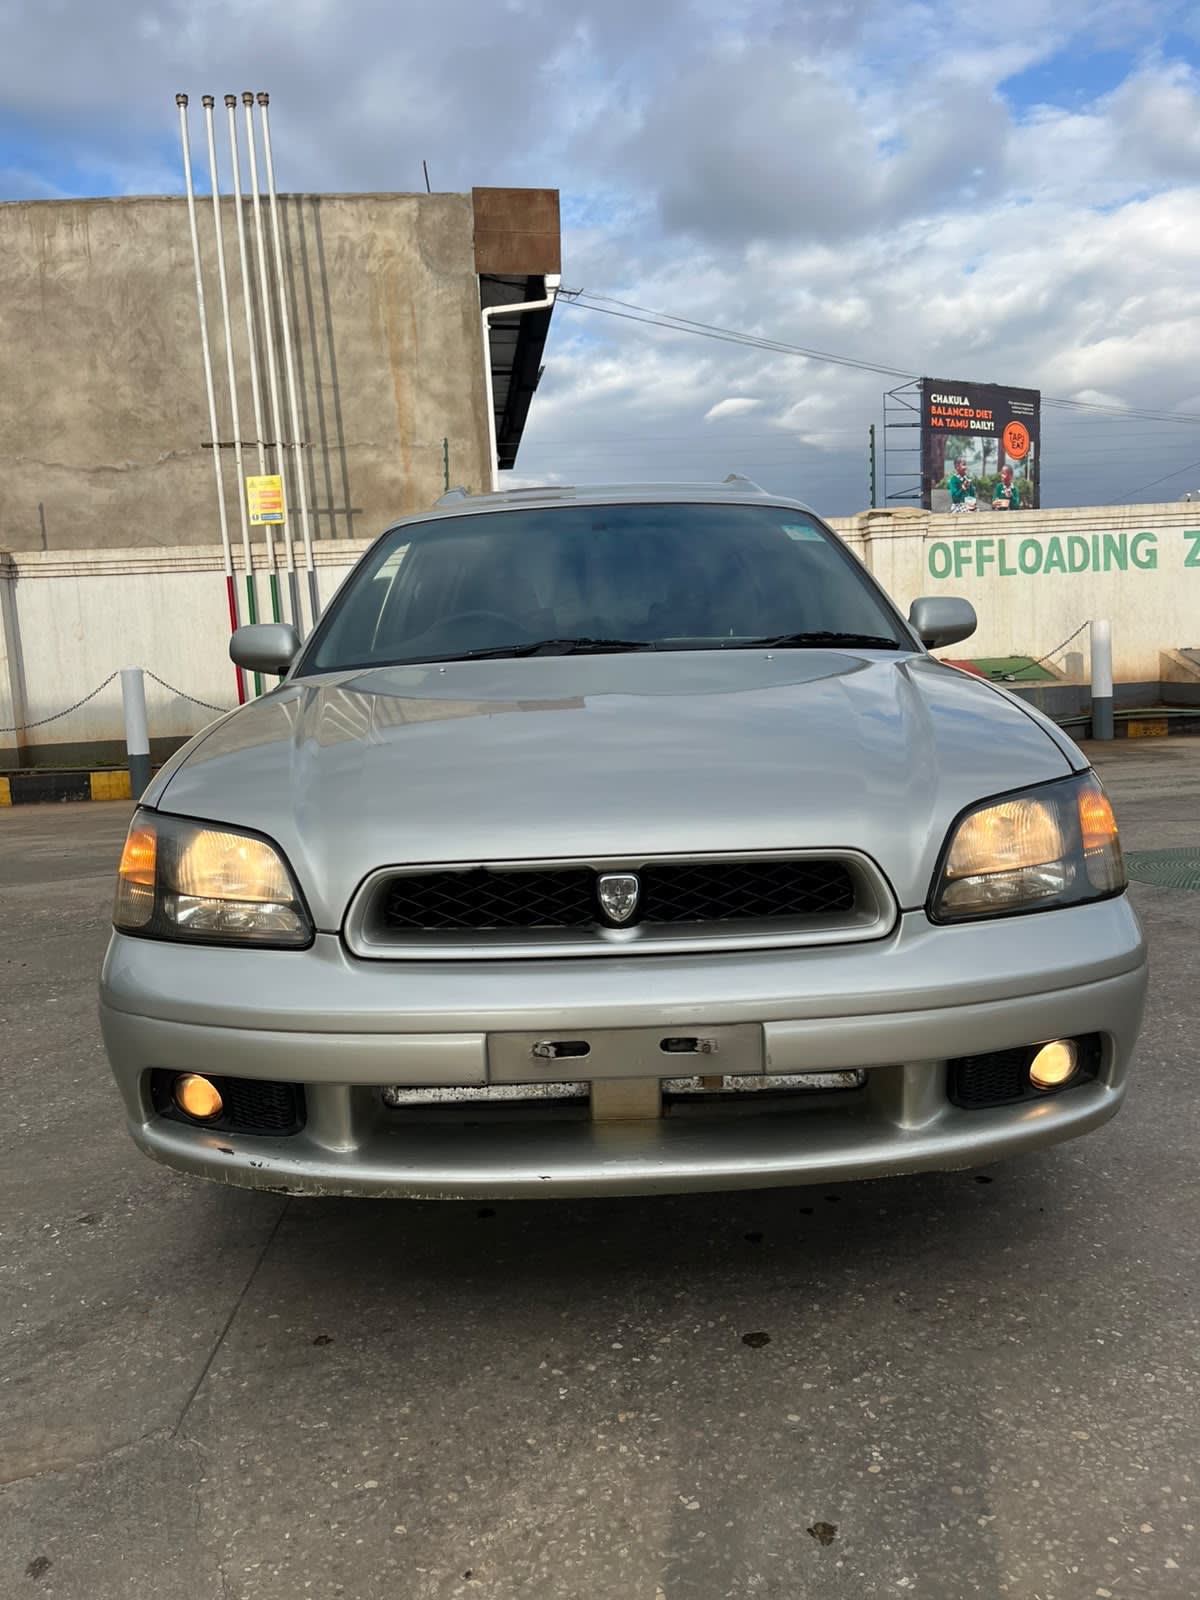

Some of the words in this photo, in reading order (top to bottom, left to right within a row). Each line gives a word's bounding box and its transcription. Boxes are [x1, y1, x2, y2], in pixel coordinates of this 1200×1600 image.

[931, 394, 969, 406] CHAKULA
[931, 406, 974, 418] BALANCED
[976, 409, 993, 419] DIET
[931, 418, 944, 427] NA
[945, 418, 969, 429] TAMU
[970, 420, 994, 431] DAILY!
[928, 532, 1158, 579] OFFLOADING
